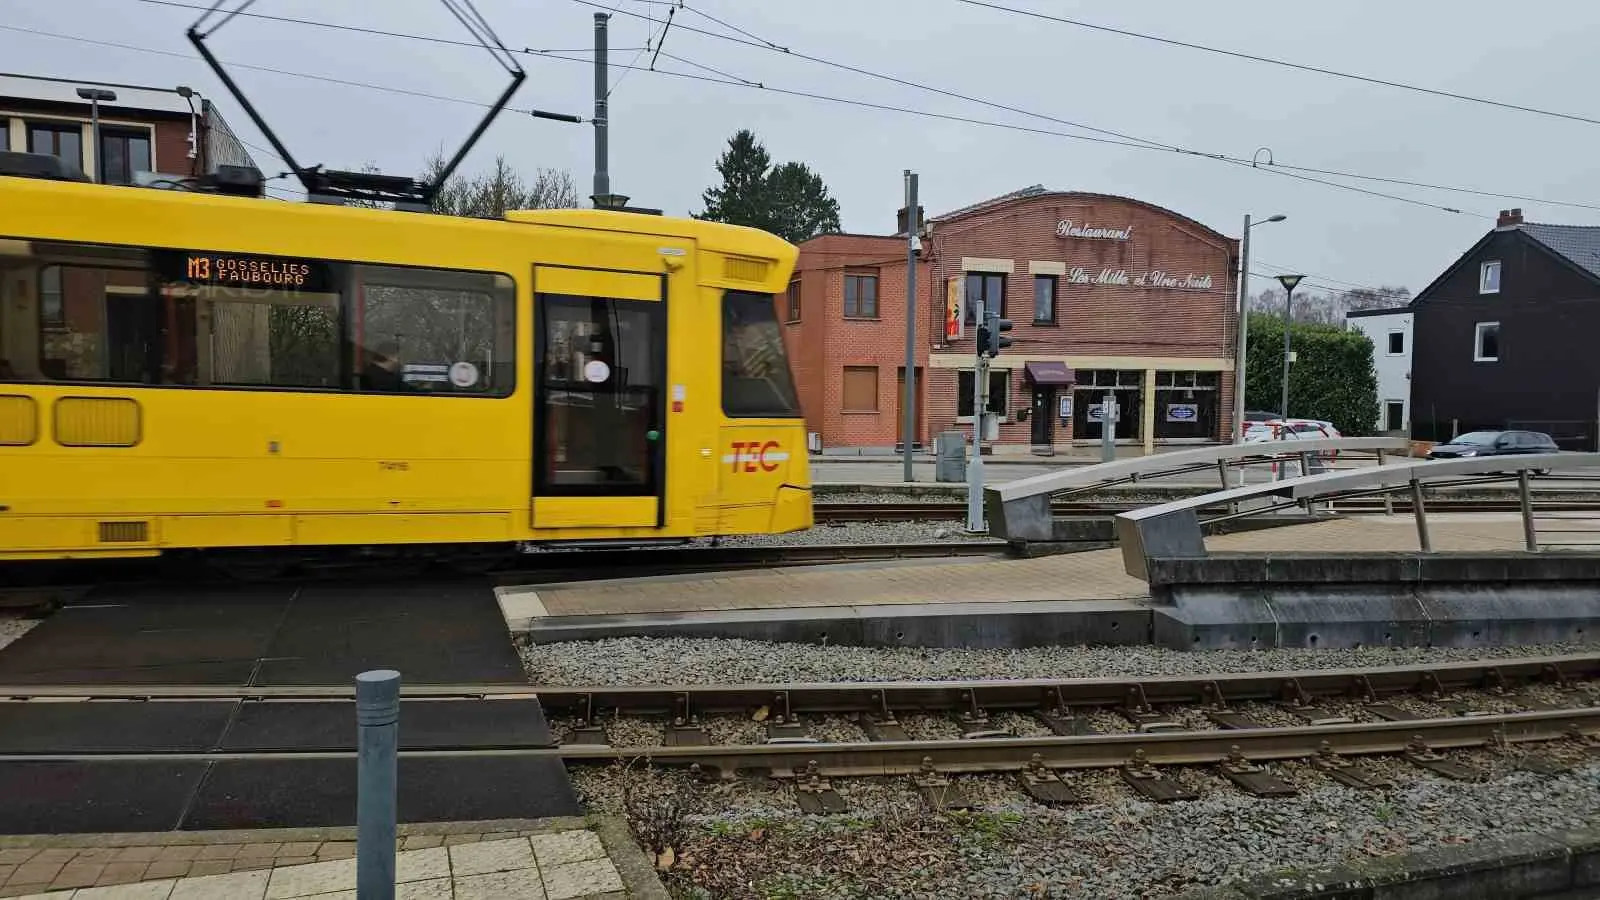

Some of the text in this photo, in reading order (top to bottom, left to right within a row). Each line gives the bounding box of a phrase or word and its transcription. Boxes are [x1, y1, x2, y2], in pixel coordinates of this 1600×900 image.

[1056, 219, 1132, 240] Restaurant
[187, 256, 210, 279] M3
[216, 259, 310, 275] GOSSELIES
[219, 269, 304, 285] FAUBOURG
[1068, 267, 1212, 289] Les Mille et Une Nuits
[731, 440, 780, 473] TEC
